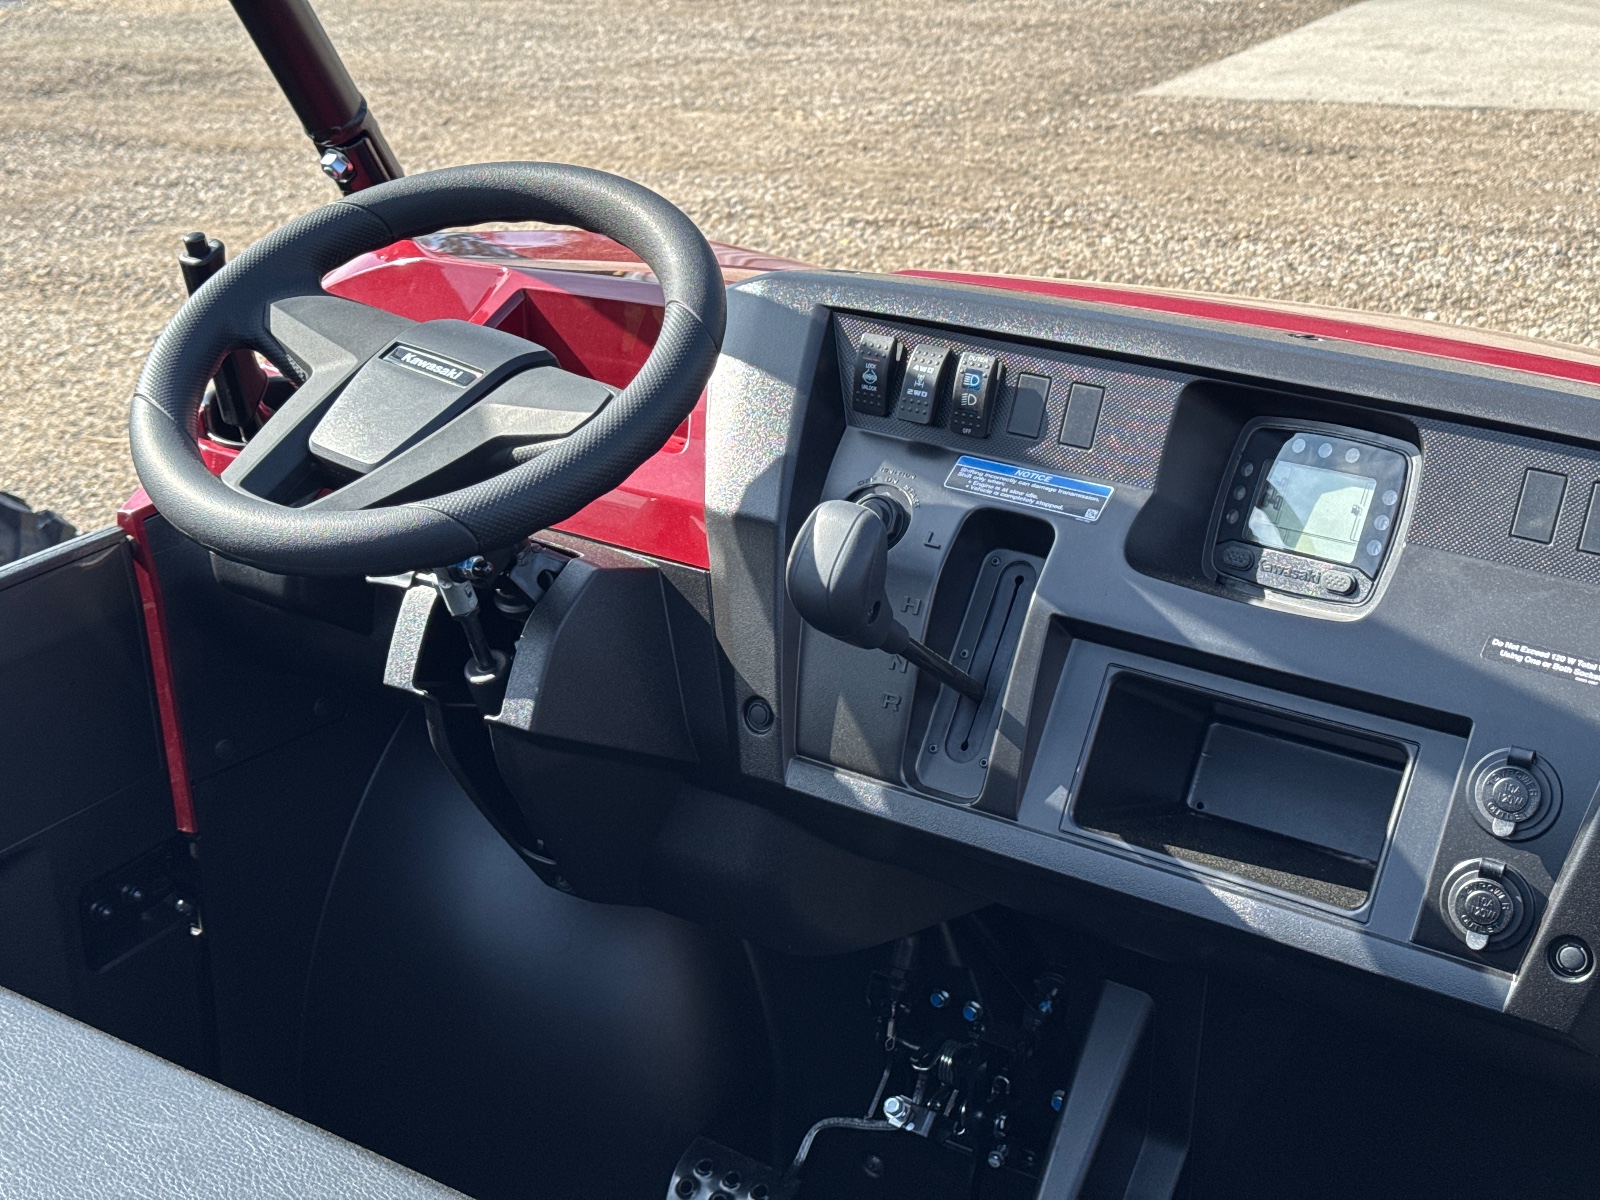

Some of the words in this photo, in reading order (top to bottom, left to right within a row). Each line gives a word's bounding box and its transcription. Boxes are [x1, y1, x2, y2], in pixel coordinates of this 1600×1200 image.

[400, 352, 463, 380] Kawasaki
[912, 364, 935, 374] 4WD
[861, 383, 878, 392] UNLOCK
[906, 388, 928, 398] 2WD
[884, 476, 899, 485] ON
[957, 471, 972, 479] Shift
[973, 475, 986, 483] only
[960, 467, 984, 477] Shifting
[985, 472, 1017, 485] incorrectly
[1031, 483, 1057, 493] damage
[1014, 469, 1053, 483] NOTICE
[970, 485, 993, 495] Vehicle
[1000, 491, 1035, 504] completely
[1035, 500, 1063, 511] stopped.
[972, 480, 994, 490] Engine
[1009, 489, 1025, 497] slow
[1025, 491, 1038, 500] idle.
[924, 531, 941, 549] L
[901, 595, 922, 616] H
[1492, 638, 1504, 647] Do
[1505, 641, 1520, 651] Not
[1520, 645, 1551, 659] Exceed
[1551, 653, 1566, 663] 120
[1567, 656, 1577, 665] W
[1577, 659, 1598, 671] Total
[1499, 649, 1524, 663] Using
[1524, 656, 1541, 666] One
[1541, 661, 1552, 669] or
[1552, 663, 1573, 674] Both
[1573, 668, 1600, 681] Socke
[882, 692, 902, 712] R
